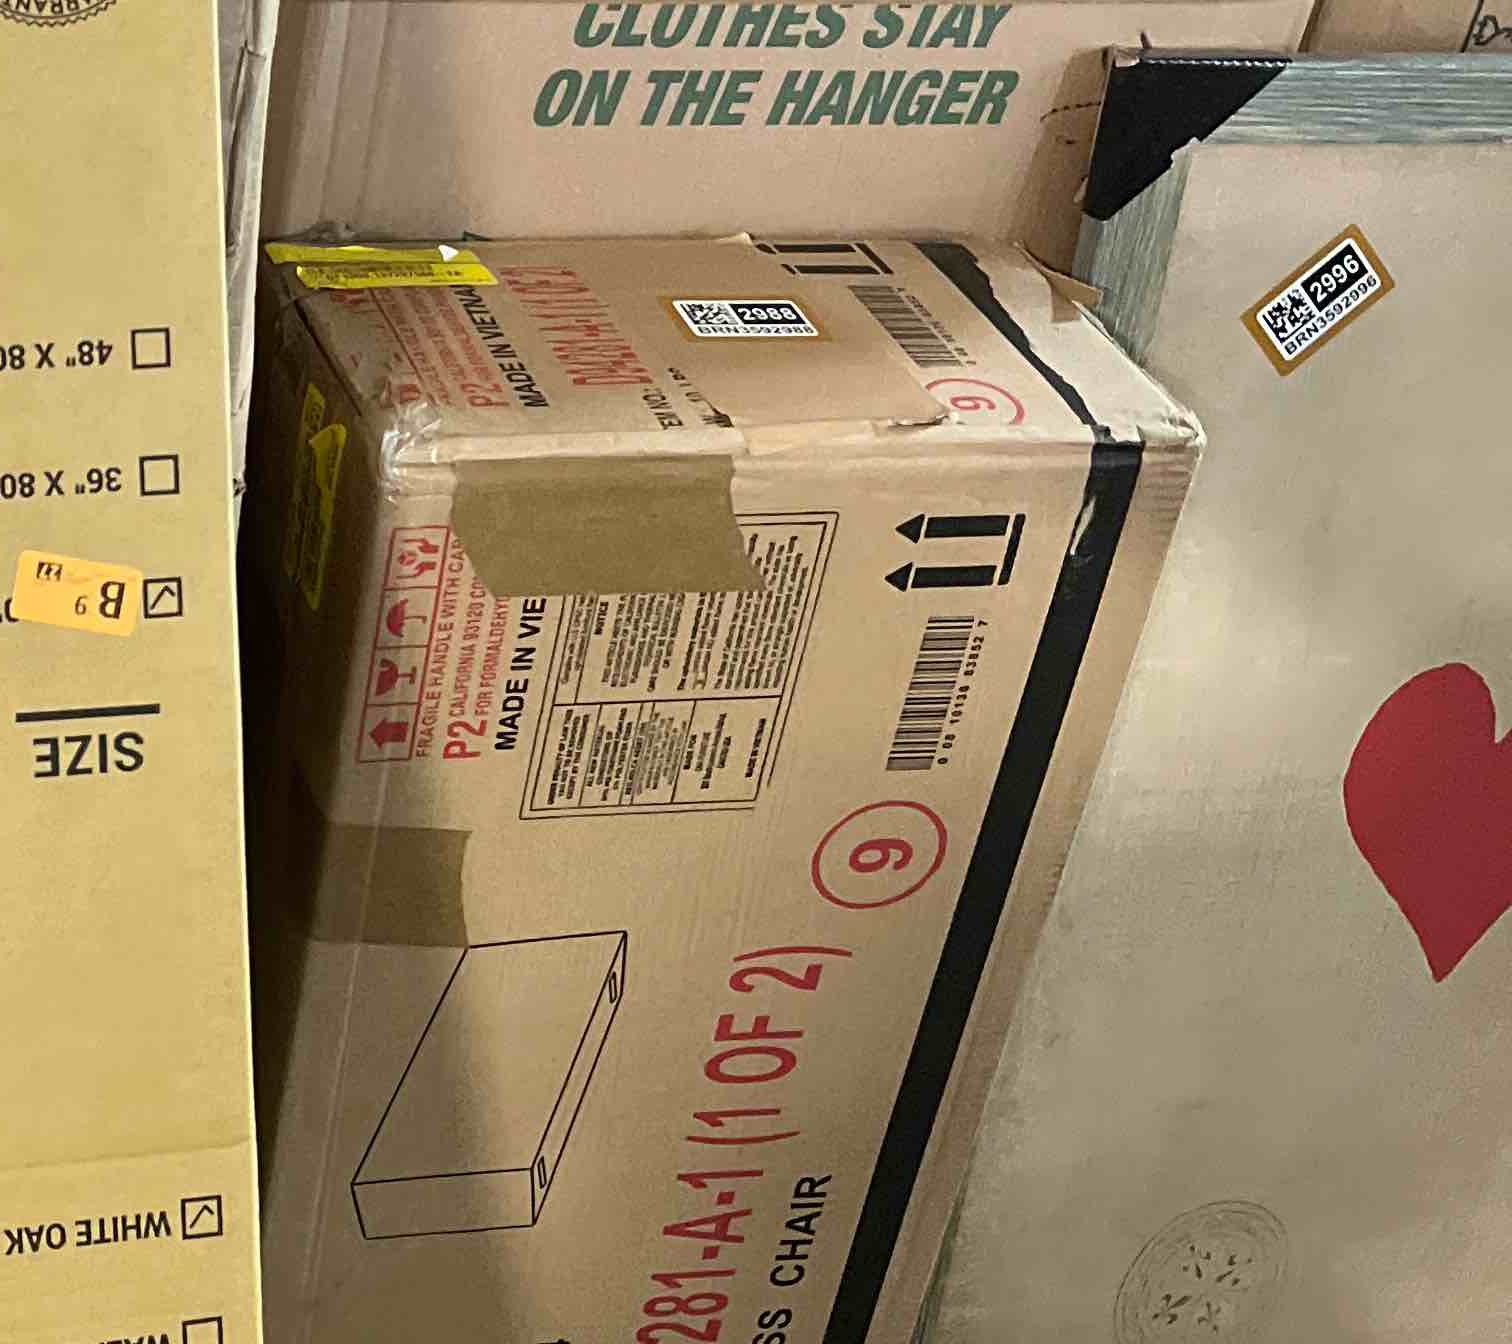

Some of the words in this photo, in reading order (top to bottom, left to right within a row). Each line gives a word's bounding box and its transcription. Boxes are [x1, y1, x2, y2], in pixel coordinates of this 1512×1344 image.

[573, 3, 855, 48] CLOTHES
[862, 3, 1013, 48] STAY
[532, 69, 631, 127] ON
[639, 69, 765, 127] THE
[765, 69, 1020, 127] HANGER
[1309, 254, 1360, 303] 2996
[451, 284, 506, 342] VIETNA
[738, 305, 797, 323] 2988
[1284, 274, 1377, 355] BRN3592996
[34, 342, 56, 369] X
[65, 340, 114, 367] 48"
[487, 343, 514, 359] IN
[499, 361, 550, 409] MADE
[43, 470, 65, 496] X
[74, 467, 123, 494] 36"
[448, 537, 466, 574] CAR
[98, 581, 126, 619] B
[439, 577, 461, 622] WITH
[429, 622, 454, 687] HANDLE
[449, 644, 476, 717] CALIFORNIA
[463, 602, 483, 641] 93120
[510, 646, 537, 673] IN
[416, 689, 443, 758] FRAGILE
[475, 694, 492, 717] FOR
[494, 677, 530, 752] MADE
[32, 731, 144, 778] SIZE
[442, 719, 488, 760] P2
[728, 945, 853, 992] 2)
[703, 1013, 804, 1085] OF
[3, 1222, 67, 1256] OAK
[73, 1210, 172, 1247] WHITE
[768, 1173, 833, 1288] CHAIR
